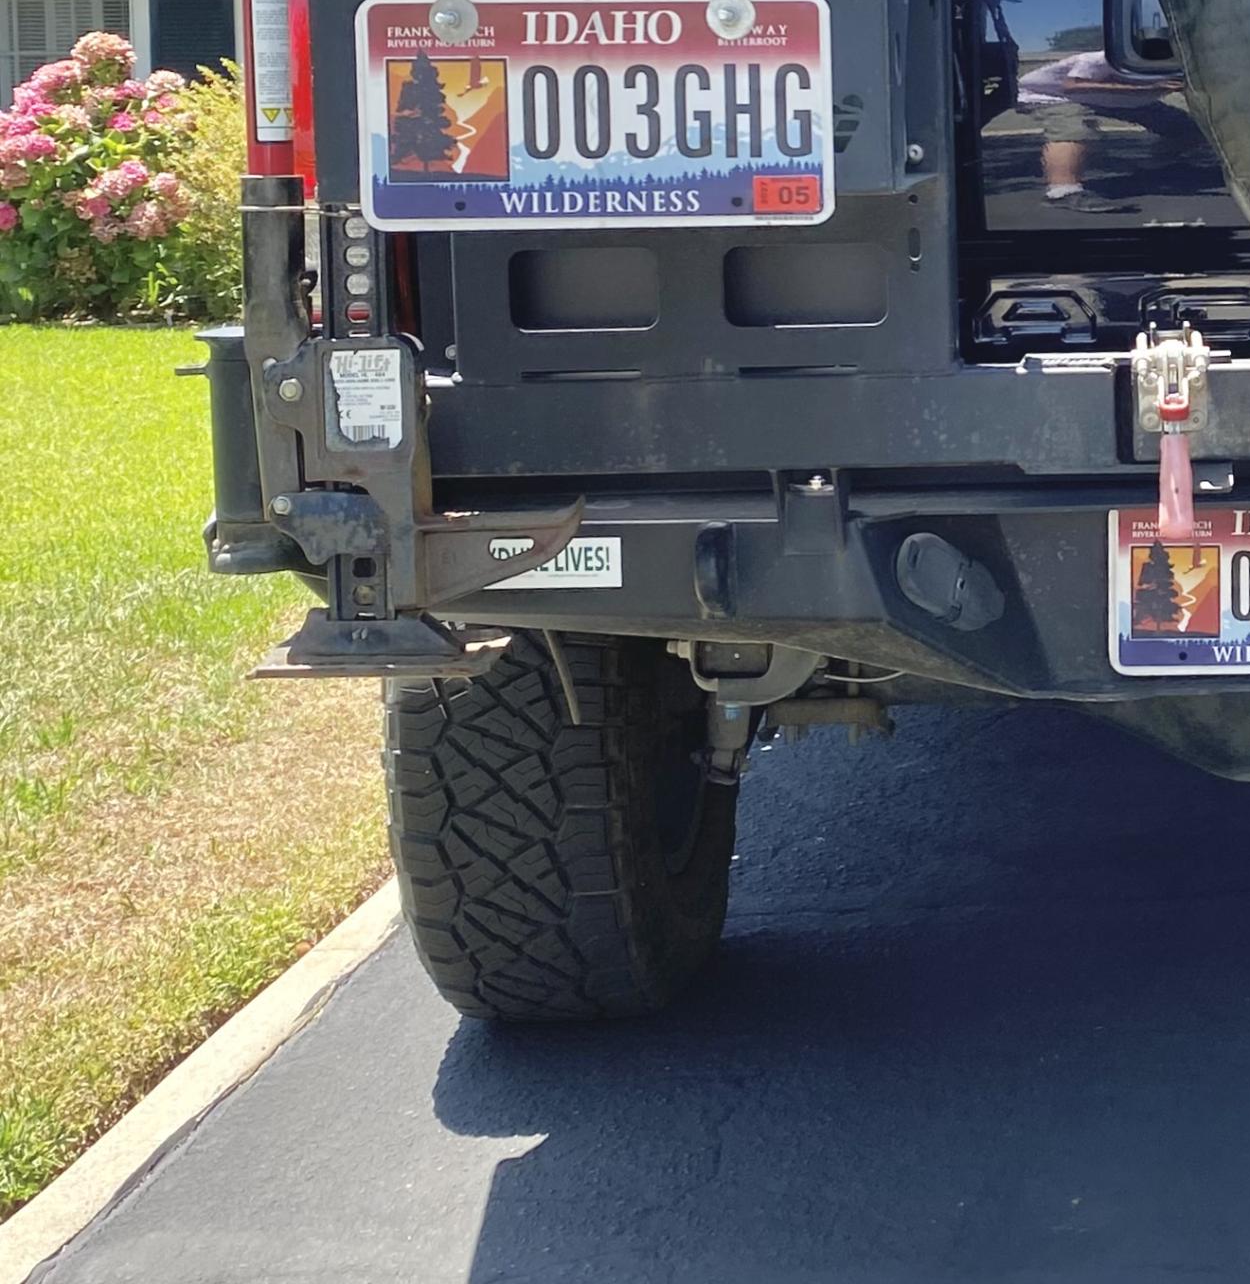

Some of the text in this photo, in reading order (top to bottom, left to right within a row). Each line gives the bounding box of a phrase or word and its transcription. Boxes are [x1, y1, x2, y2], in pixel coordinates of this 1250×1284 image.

[387, 26, 432, 37] FRANK
[521, 10, 682, 45] IDAHO
[387, 39, 416, 48] RIVER
[419, 39, 433, 48] OF
[521, 62, 813, 160] 003GHG
[501, 189, 701, 214] WILDERNESS
[778, 185, 810, 205] 05
[333, 354, 391, 373] Hi-Lift
[1132, 521, 1160, 529] FRAN
[554, 546, 610, 572] LIVES!
